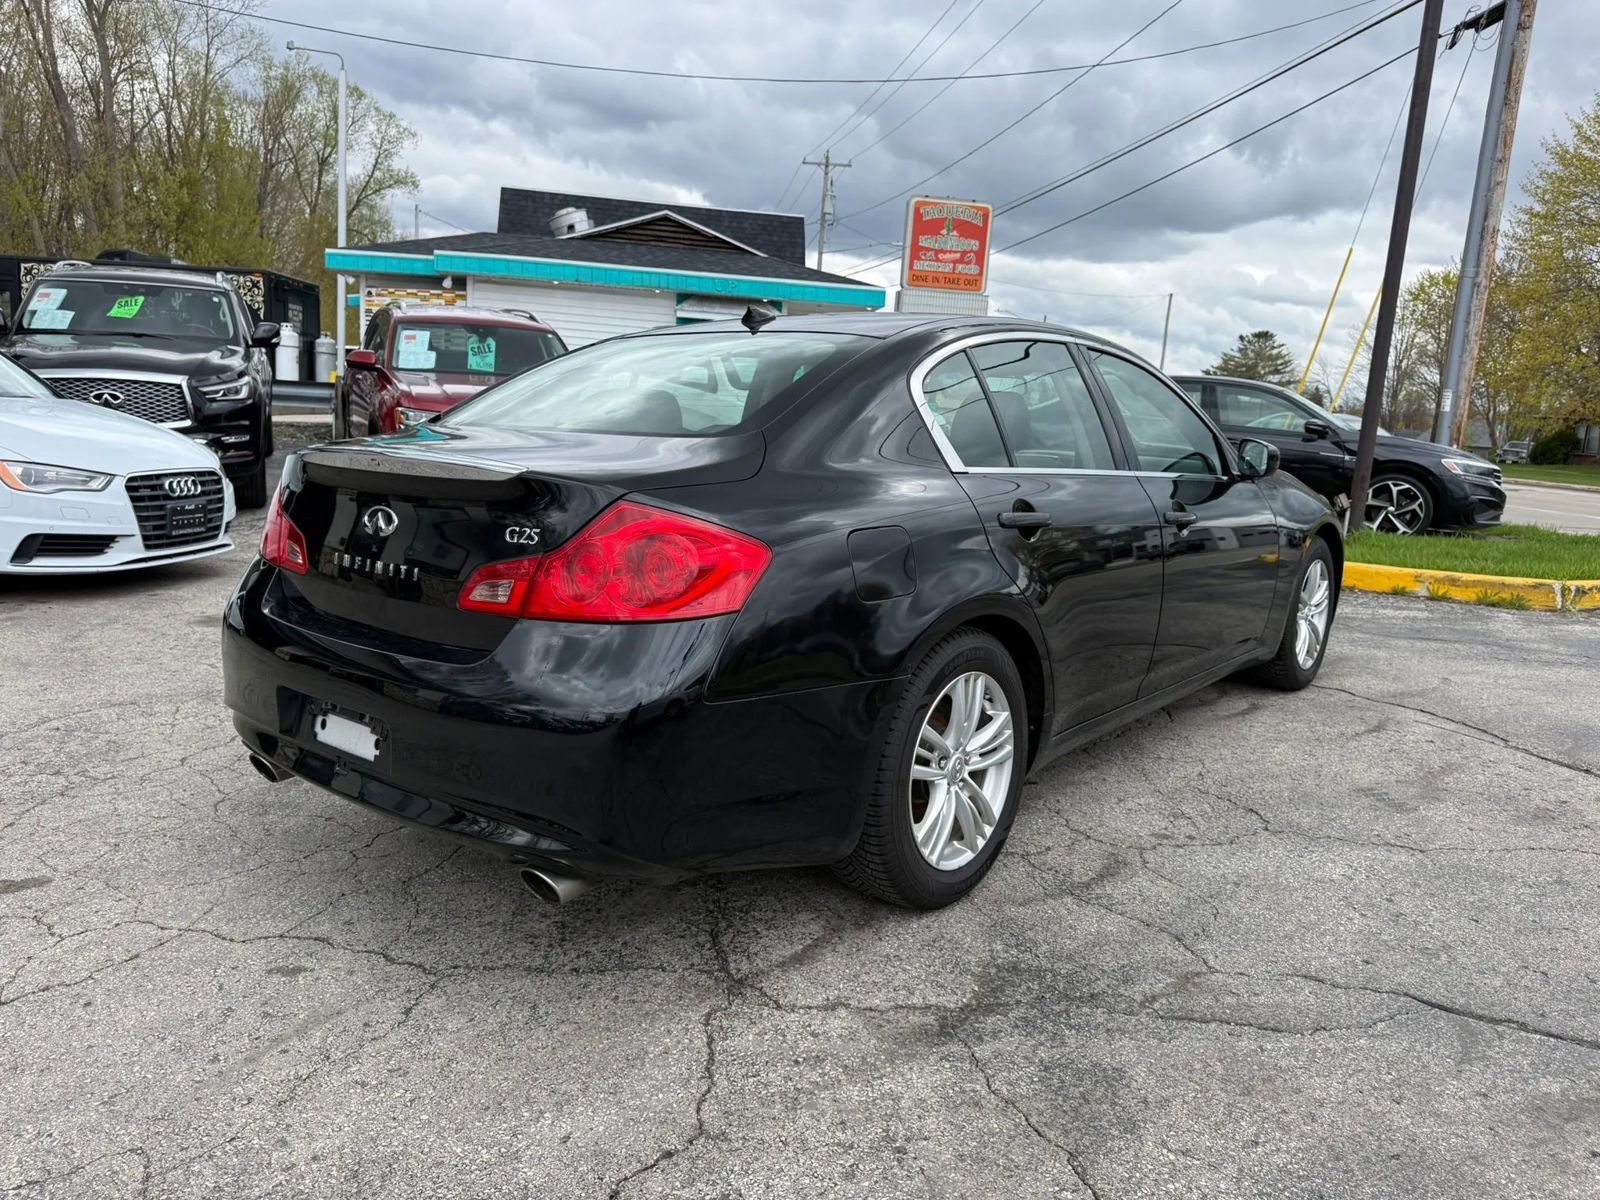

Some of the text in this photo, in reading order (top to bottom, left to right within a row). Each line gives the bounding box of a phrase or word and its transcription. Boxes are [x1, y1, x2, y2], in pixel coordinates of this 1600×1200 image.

[920, 204, 983, 227] TAQUERIA
[955, 263, 980, 275] FOOD
[912, 274, 929, 283] DINE
[963, 278, 979, 287] OUT
[117, 299, 139, 309] SALE
[470, 343, 494, 357] SALE
[505, 526, 541, 544] G25
[333, 552, 419, 582] INFINITI
